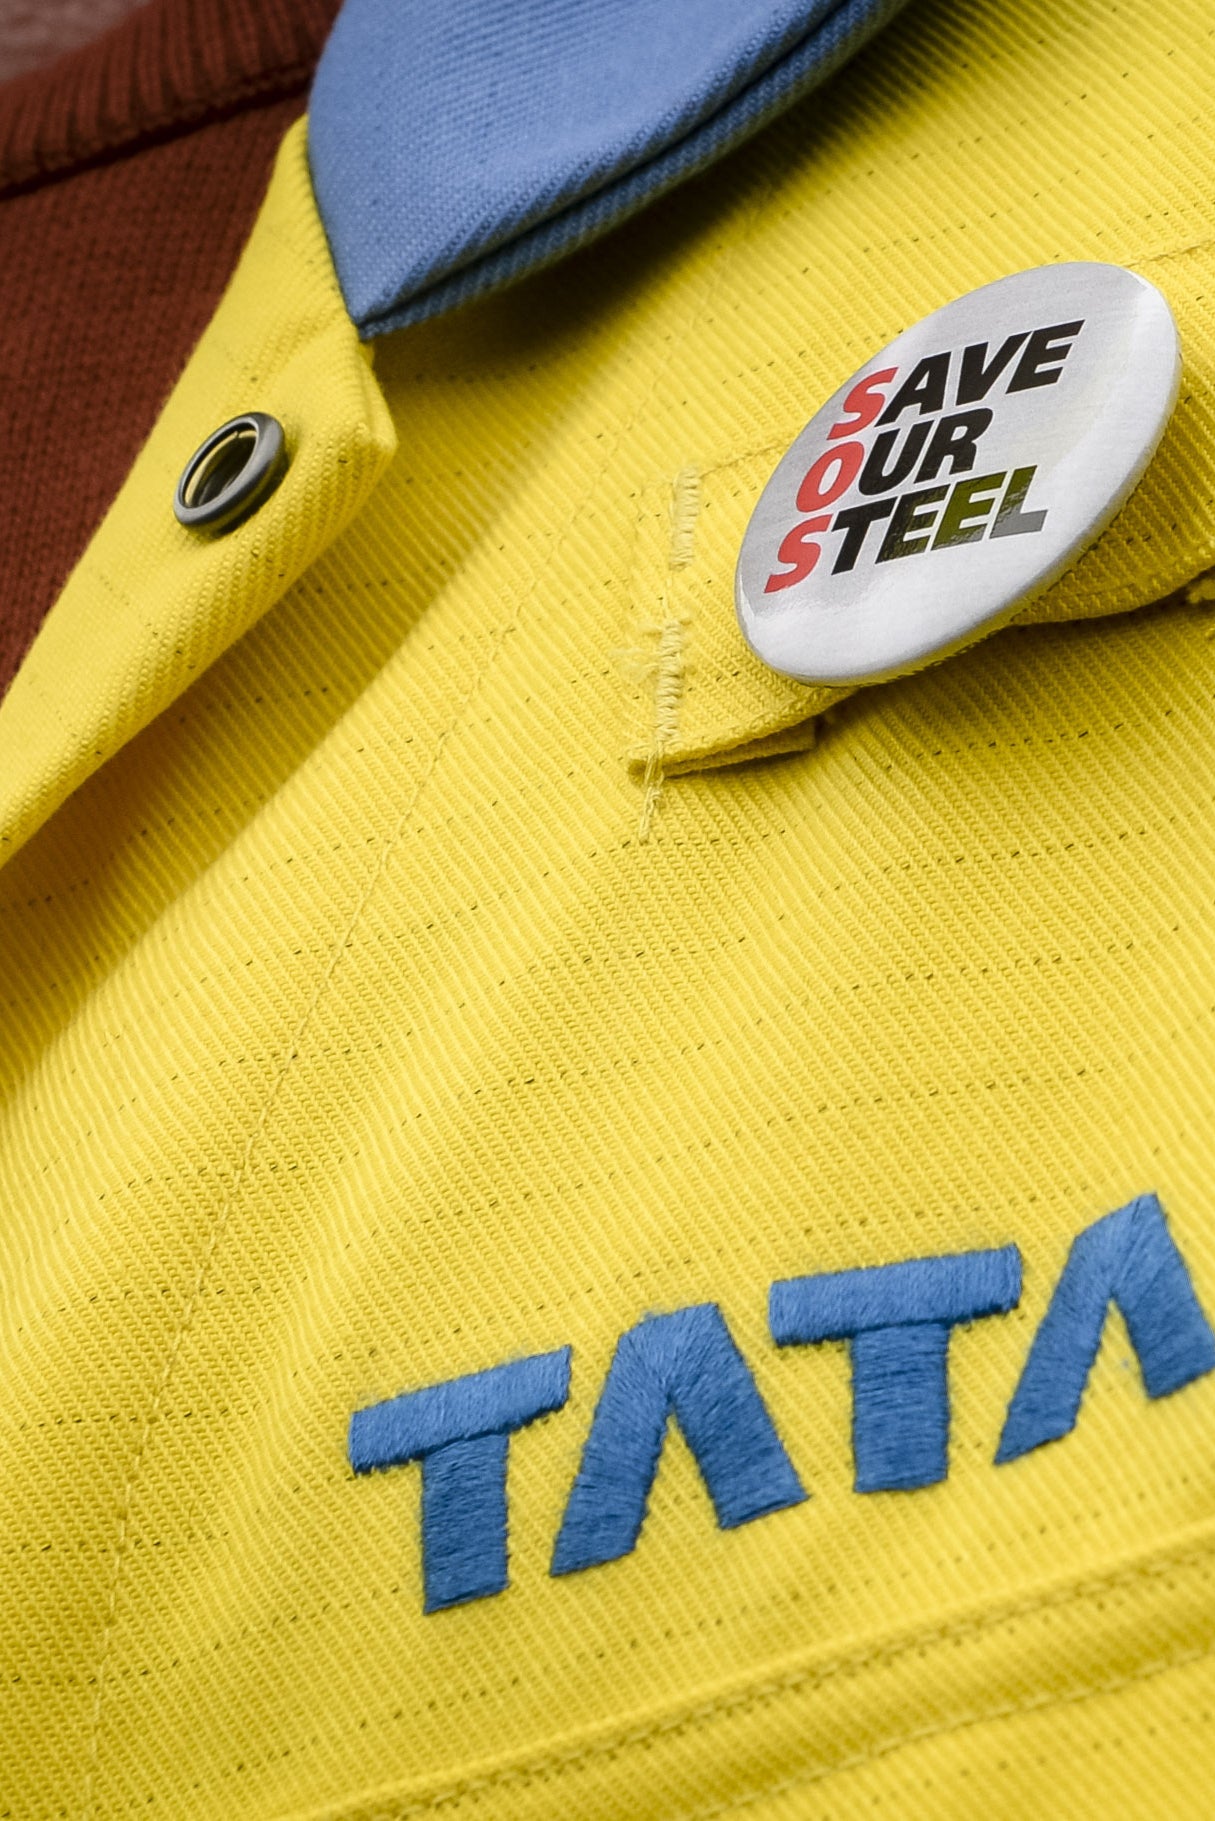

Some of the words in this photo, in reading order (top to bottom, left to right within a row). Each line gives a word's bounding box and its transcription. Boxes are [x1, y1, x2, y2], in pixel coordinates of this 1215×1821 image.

[826, 318, 1086, 441] SAVE
[795, 407, 994, 514] OUR
[763, 464, 1049, 594] STEEL
